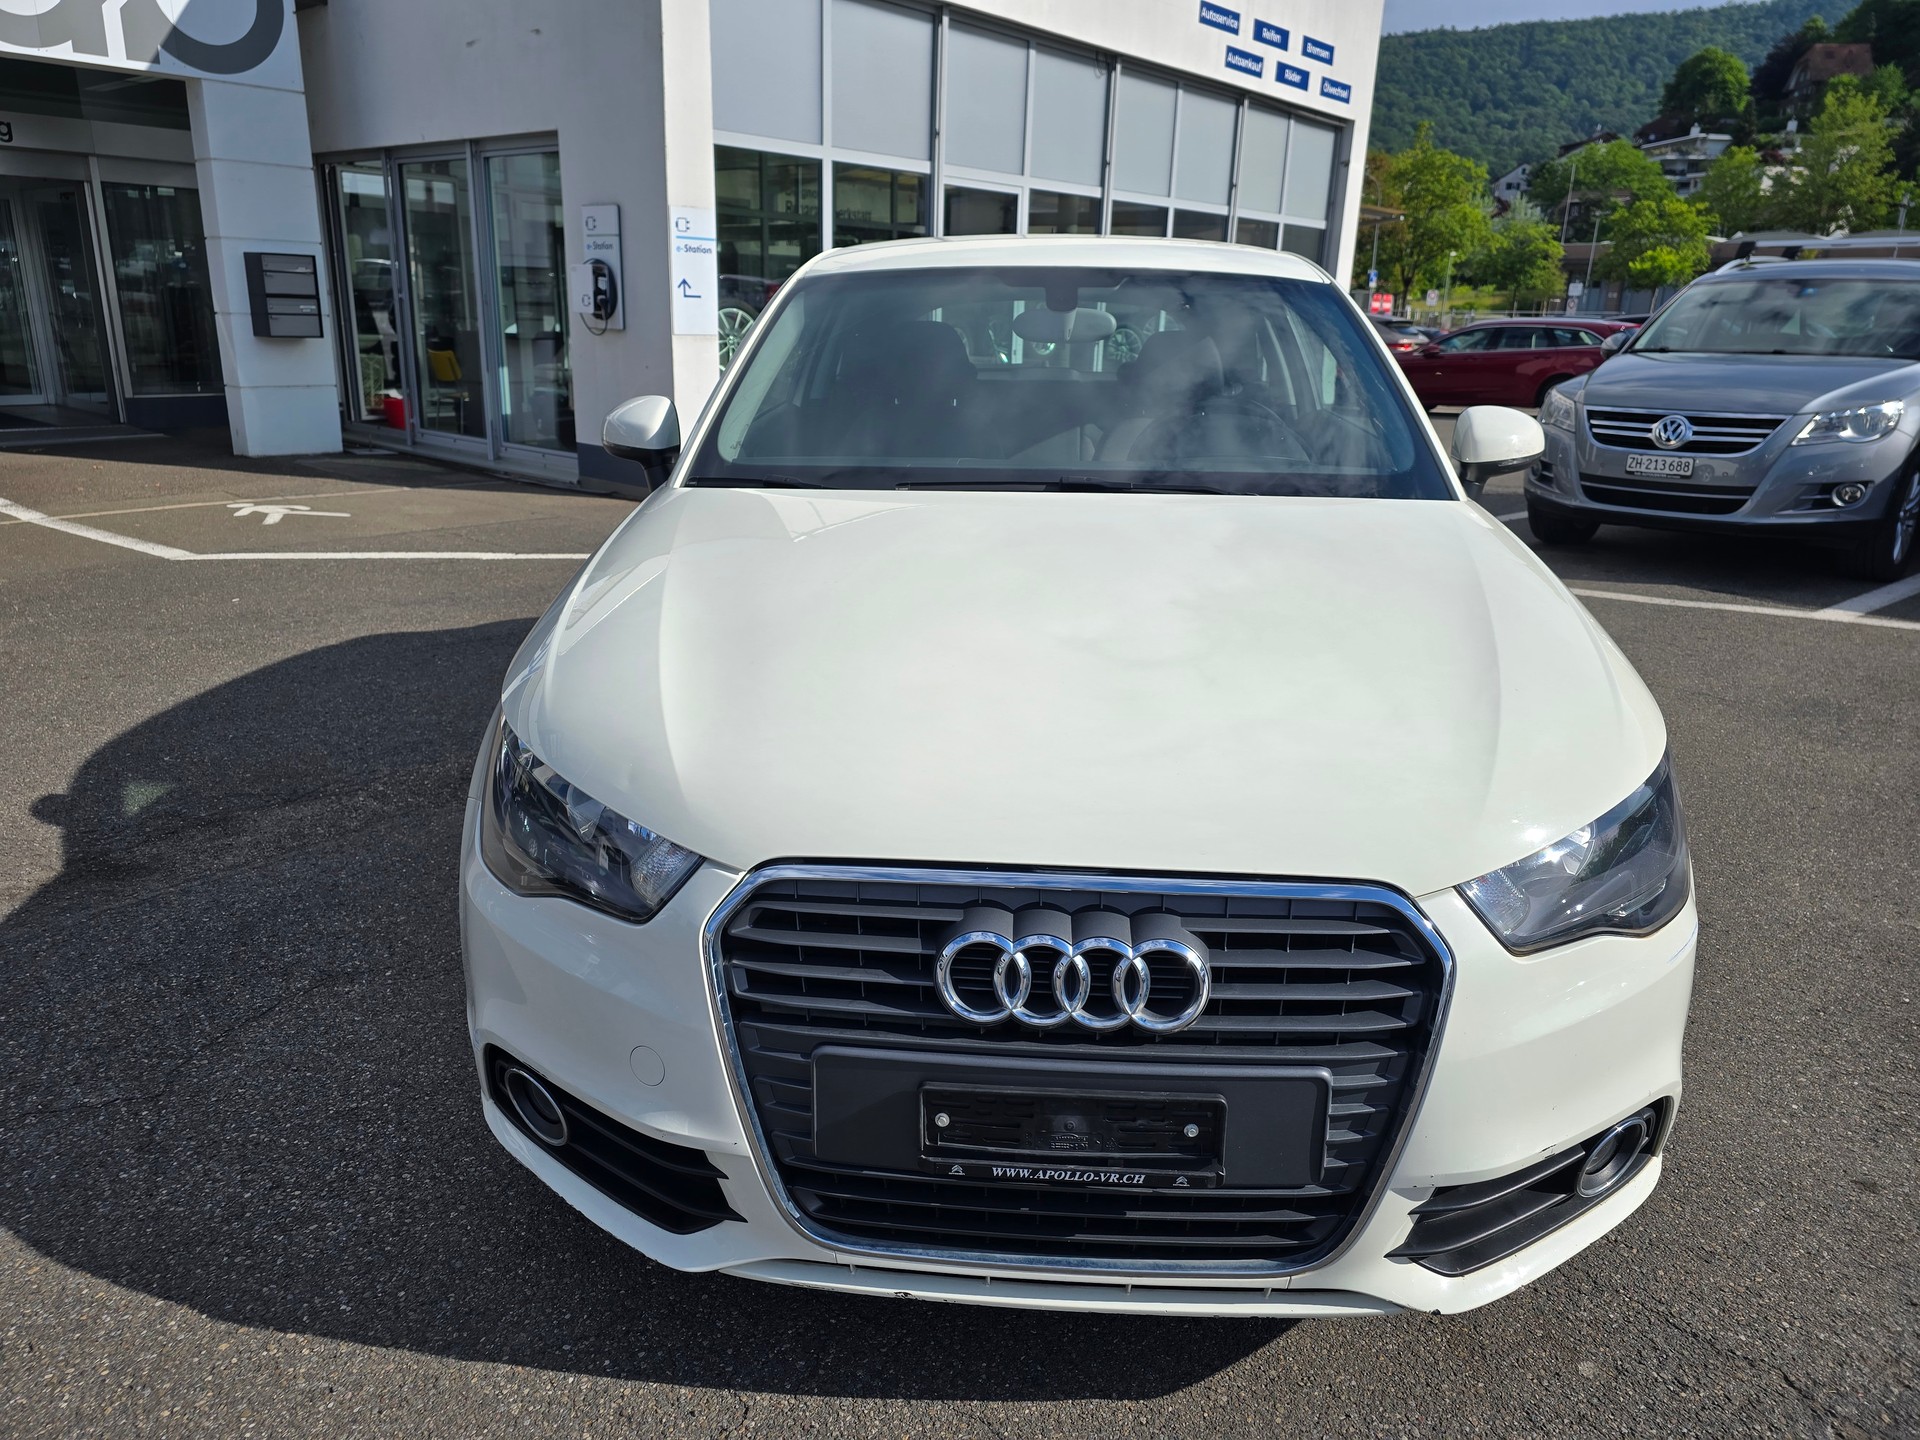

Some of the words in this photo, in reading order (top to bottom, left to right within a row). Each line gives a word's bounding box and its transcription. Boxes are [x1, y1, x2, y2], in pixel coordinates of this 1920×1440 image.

[1200, 6, 1238, 29] Autoservice
[1261, 27, 1282, 43] Reifen
[1306, 42, 1330, 59] Bremsen
[1226, 52, 1263, 73] Autoankauf
[586, 240, 614, 251] e-Station
[675, 243, 712, 255] e-Station
[991, 1166, 1146, 1185] WWW.APOLLO-VR.CH
